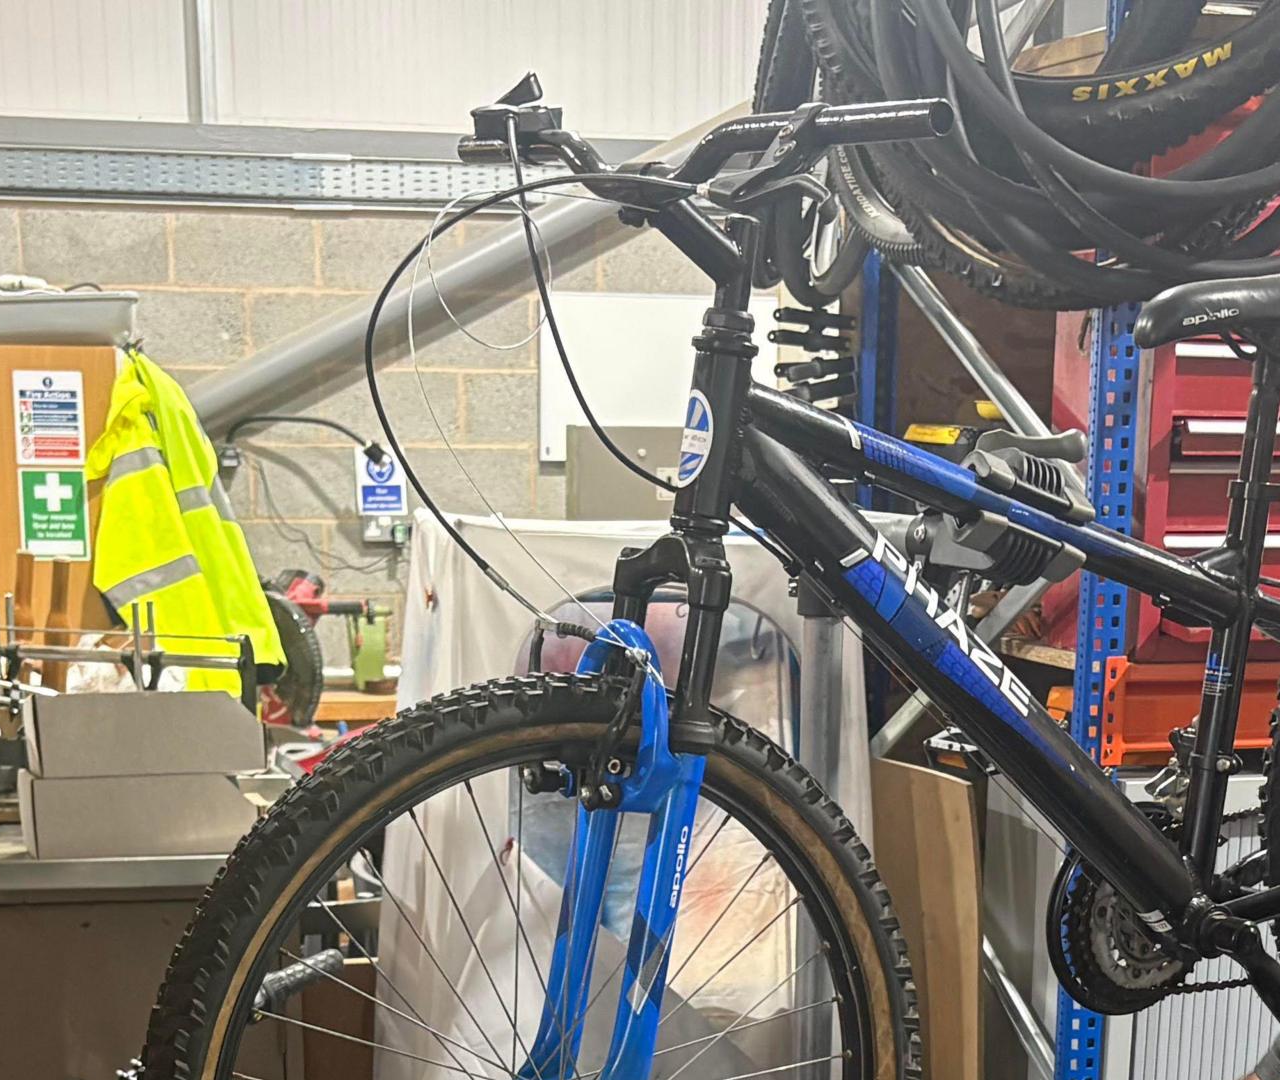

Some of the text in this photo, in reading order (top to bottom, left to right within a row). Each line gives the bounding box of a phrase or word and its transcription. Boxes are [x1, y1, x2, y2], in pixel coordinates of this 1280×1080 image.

[1072, 41, 1232, 102] MAXXIS
[872, 530, 1032, 718] PHAZE
[669, 825, 689, 909] apollo
